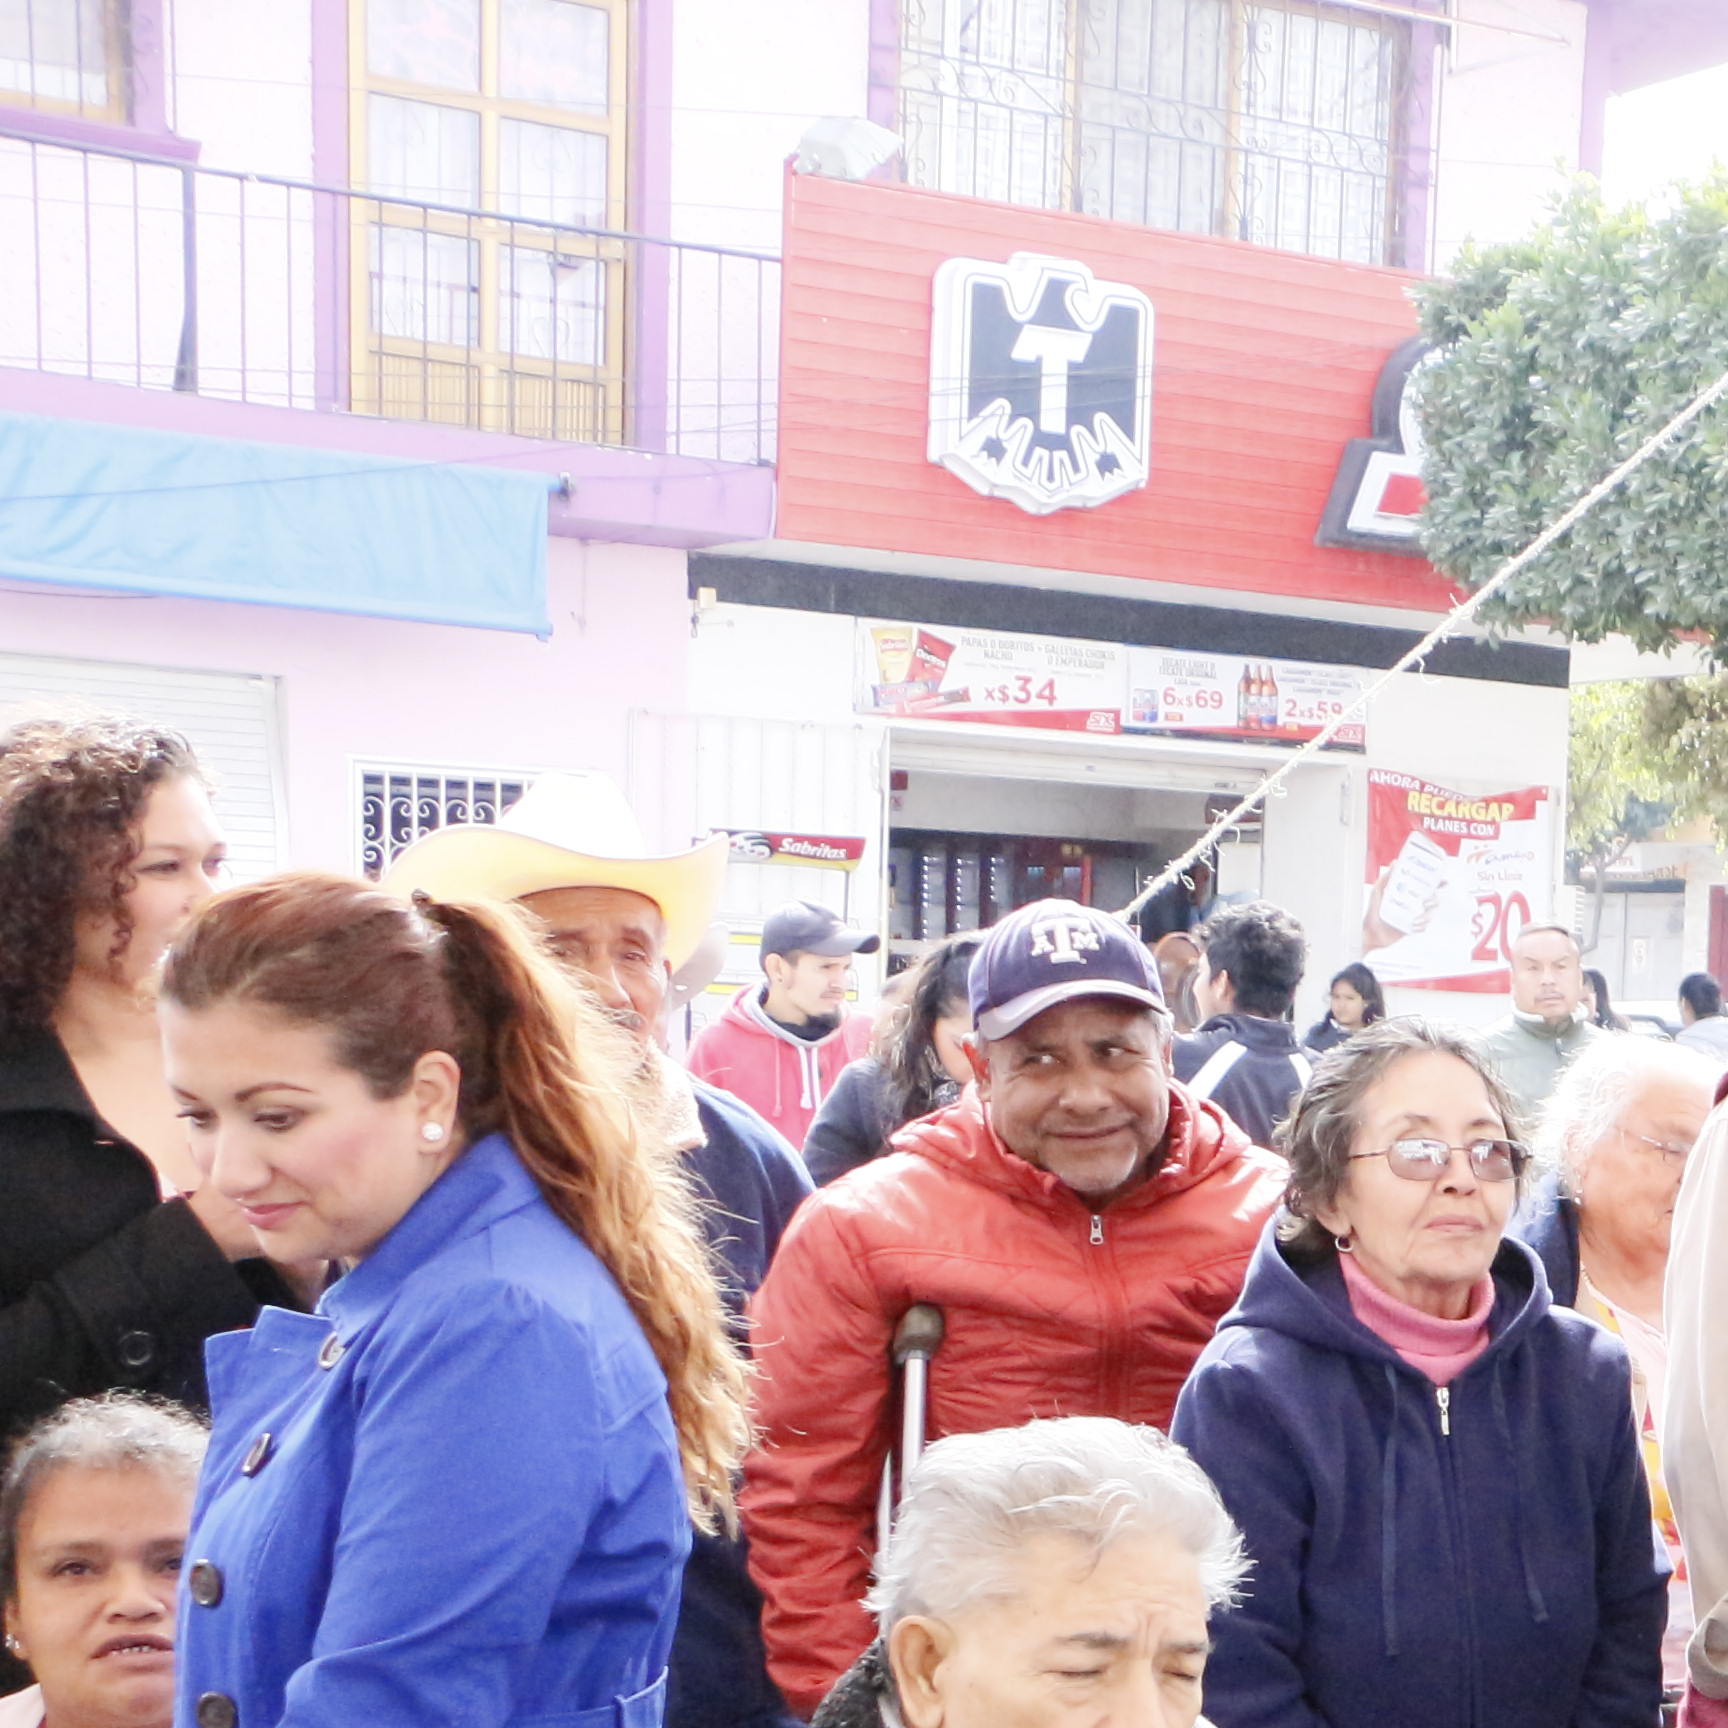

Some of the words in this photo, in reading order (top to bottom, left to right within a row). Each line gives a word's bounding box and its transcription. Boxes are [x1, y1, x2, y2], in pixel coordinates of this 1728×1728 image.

[961, 636, 988, 649] PAPAS
[1369, 770, 1420, 791] AHORA
[1423, 816, 1467, 833] PLANES
[1469, 822, 1495, 836] CON
[778, 837, 848, 860] Sabritas
[1470, 890, 1532, 963] $20
